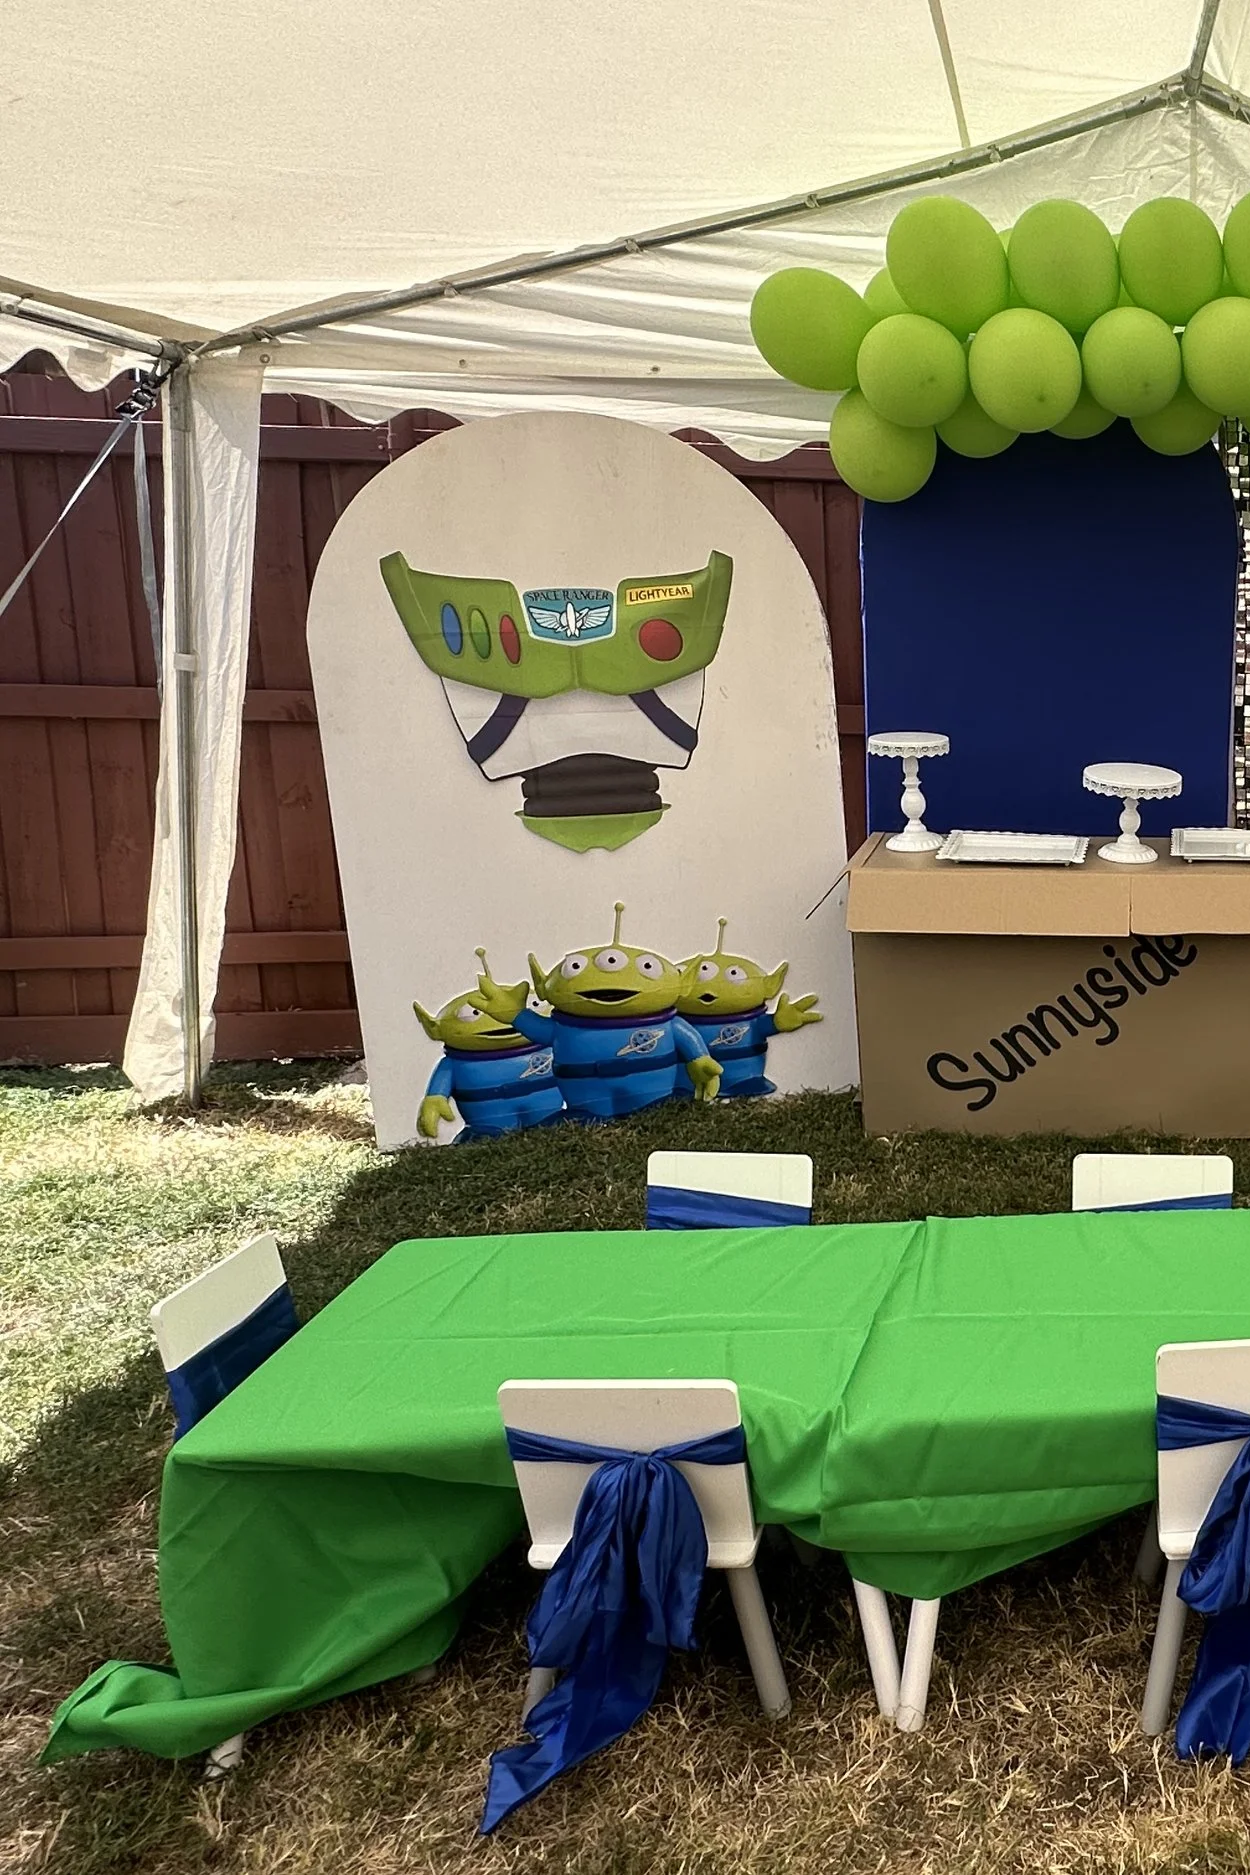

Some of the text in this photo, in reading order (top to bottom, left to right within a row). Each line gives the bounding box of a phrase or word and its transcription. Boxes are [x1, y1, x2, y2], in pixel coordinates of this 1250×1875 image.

[526, 589, 609, 602] SPACE RANGER
[629, 586, 690, 602] LIGHTYEAR
[926, 934, 1198, 1112] Sunnyside
